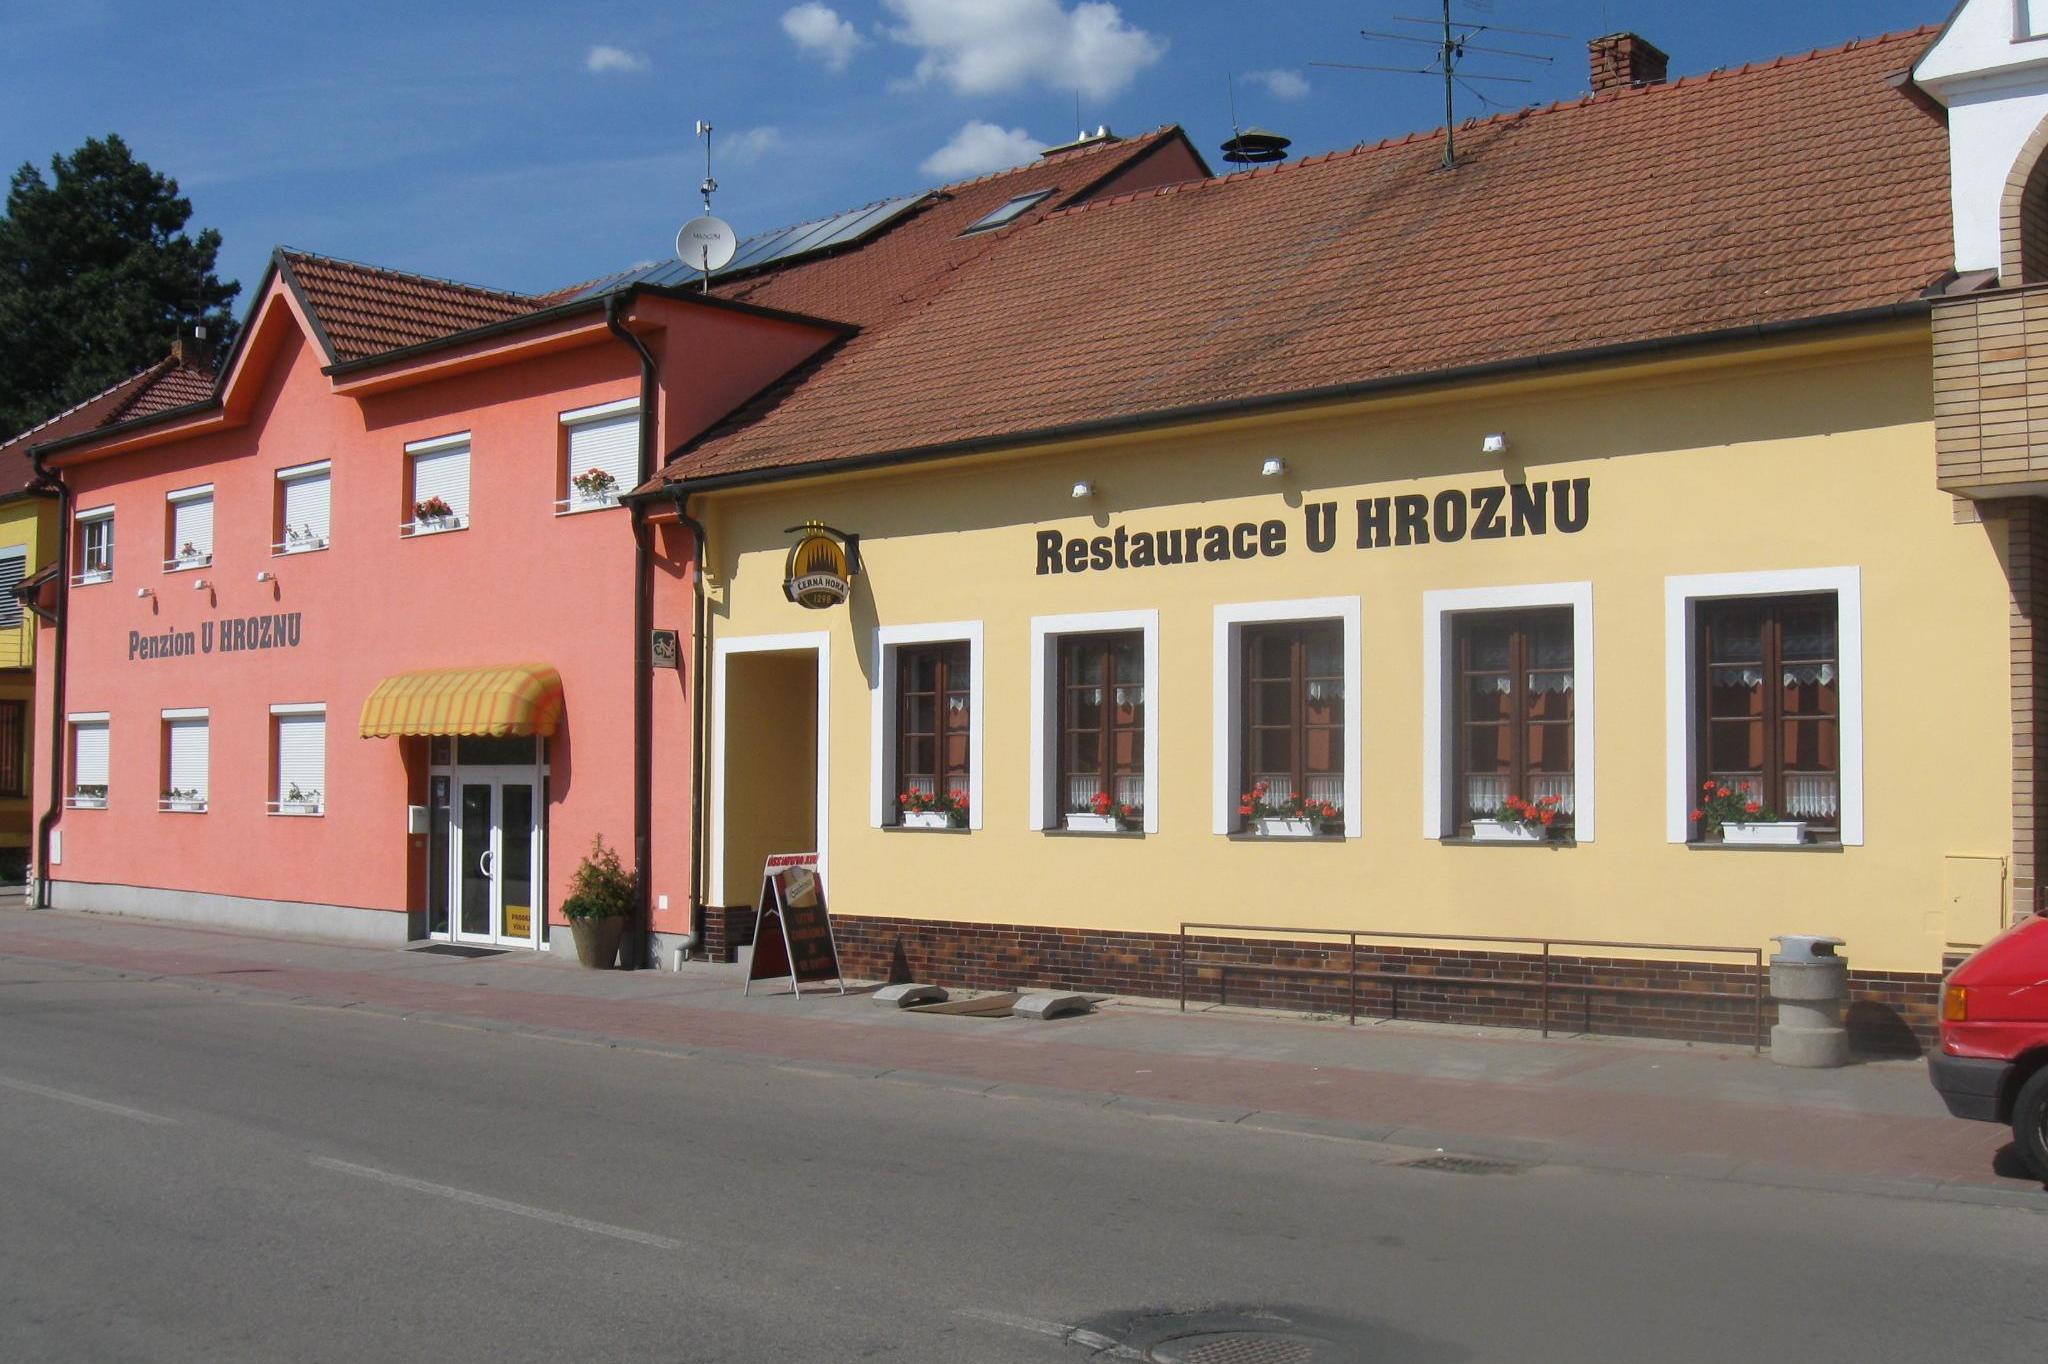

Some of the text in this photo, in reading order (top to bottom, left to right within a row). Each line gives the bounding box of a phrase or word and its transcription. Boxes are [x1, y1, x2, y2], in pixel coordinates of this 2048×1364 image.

[1035, 477, 1591, 576] Restaurace U HROZNU
[825, 578, 844, 592] HORA
[128, 612, 302, 661] Penzion U HROZNU
